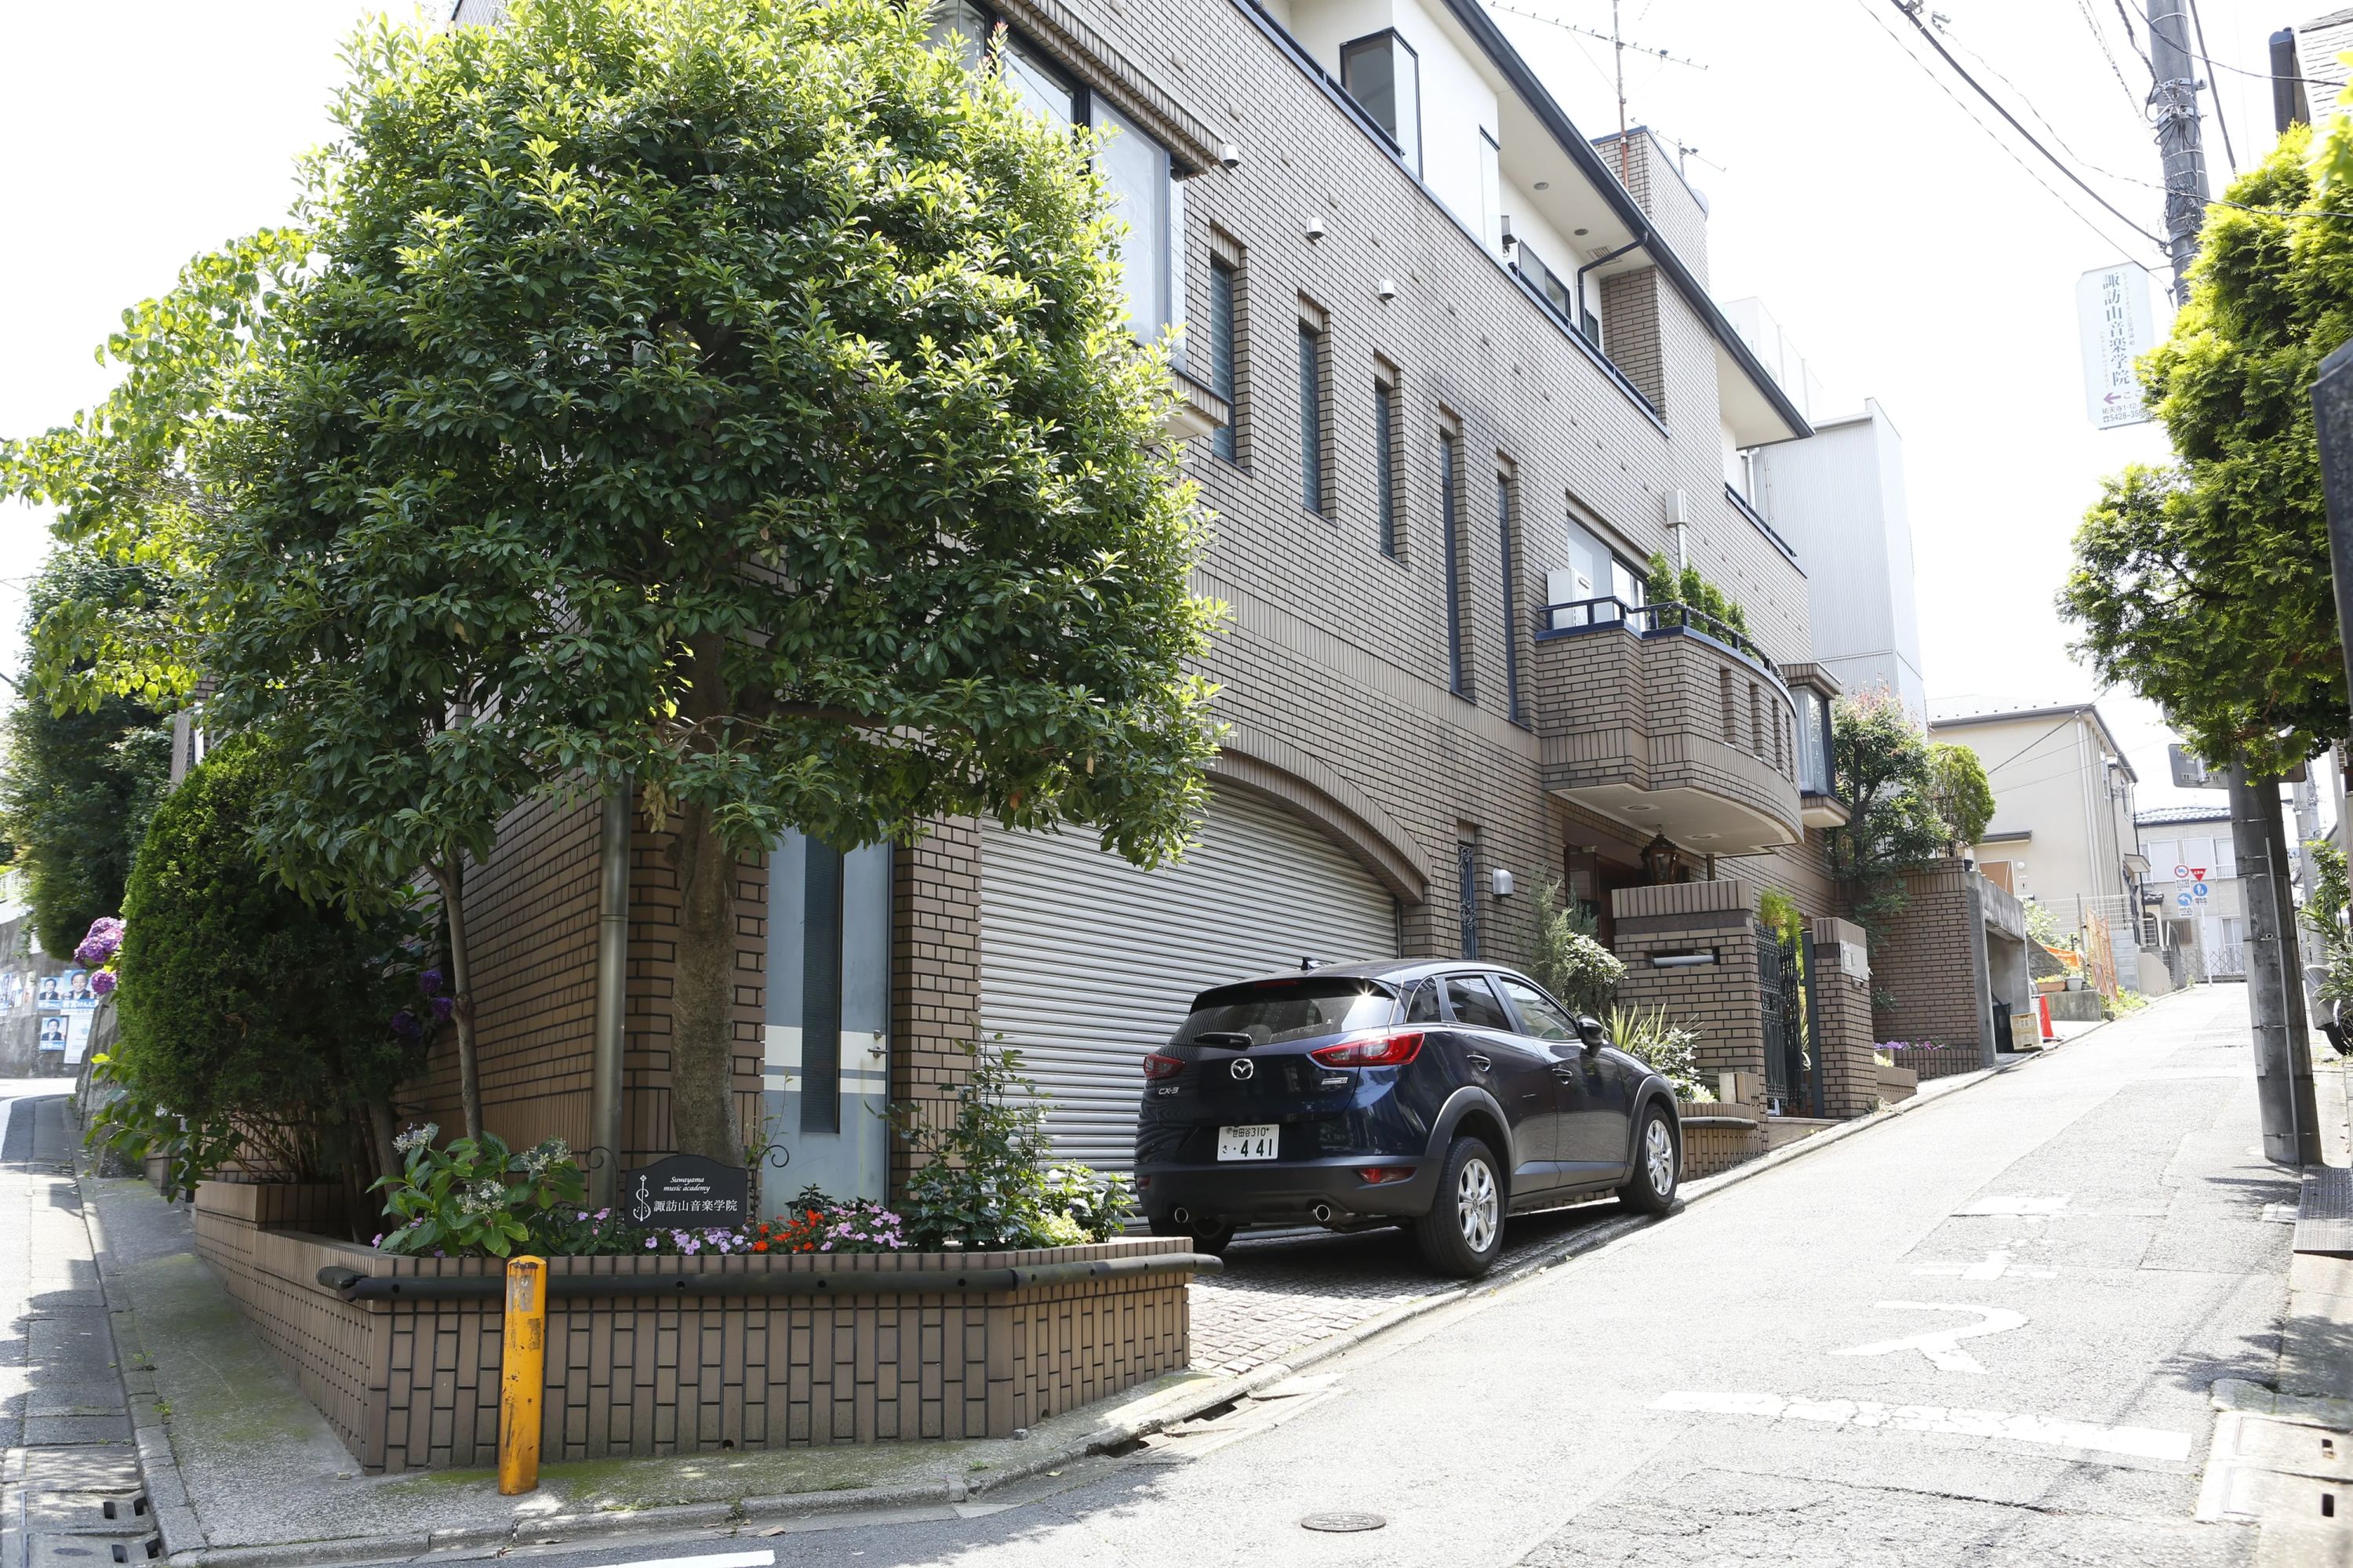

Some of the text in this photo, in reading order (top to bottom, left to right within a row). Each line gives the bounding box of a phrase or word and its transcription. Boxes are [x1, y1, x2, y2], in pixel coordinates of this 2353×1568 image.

[2103, 272, 2130, 387] 諏訪山音楽学院
[2102, 402, 2144, 415] 祐天寺1-12-1
[1158, 1086, 1180, 1095] CX-3
[670, 1177, 704, 1185] Suwayama
[682, 1184, 711, 1194] academy
[653, 1199, 737, 1212] 諏訪山音楽学院
